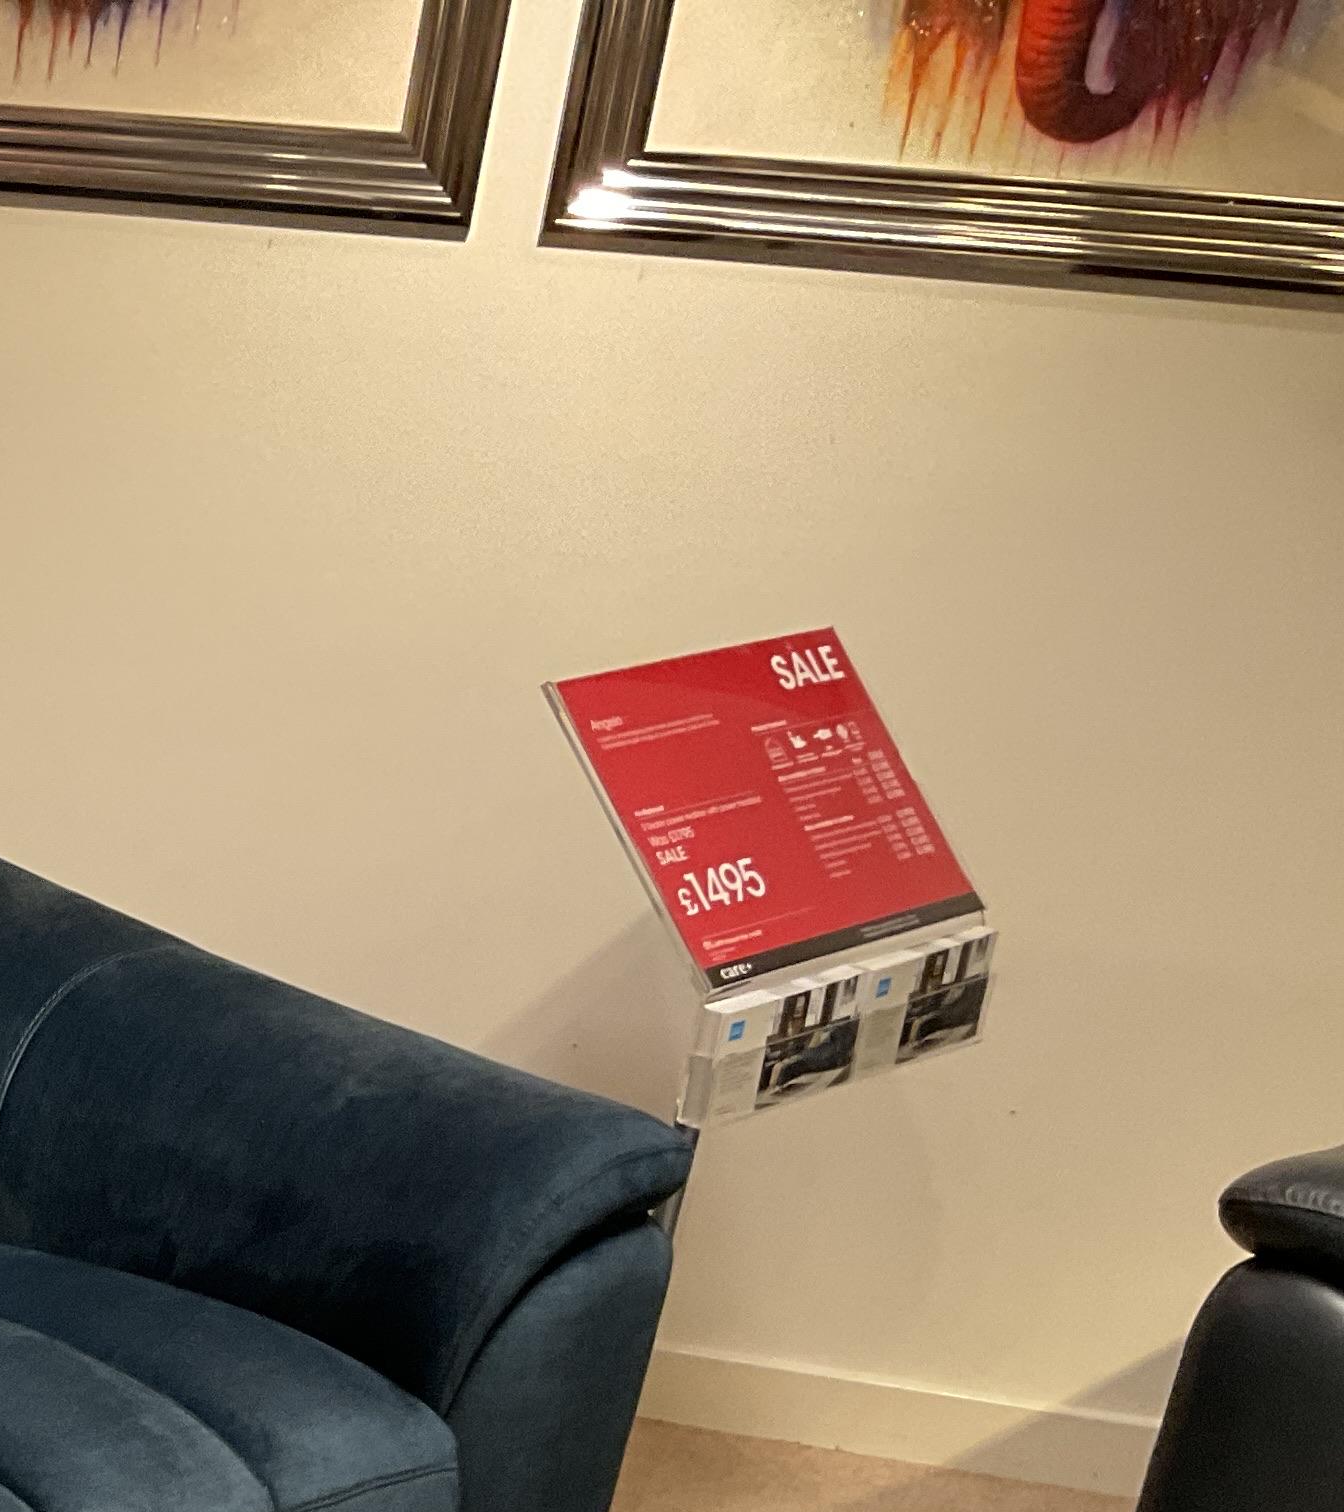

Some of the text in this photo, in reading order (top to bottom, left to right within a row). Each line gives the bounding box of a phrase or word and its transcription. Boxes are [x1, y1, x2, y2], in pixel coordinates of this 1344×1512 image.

[770, 644, 846, 690] SALE
[655, 845, 690, 866] SALE
[677, 857, 766, 917] £1495
